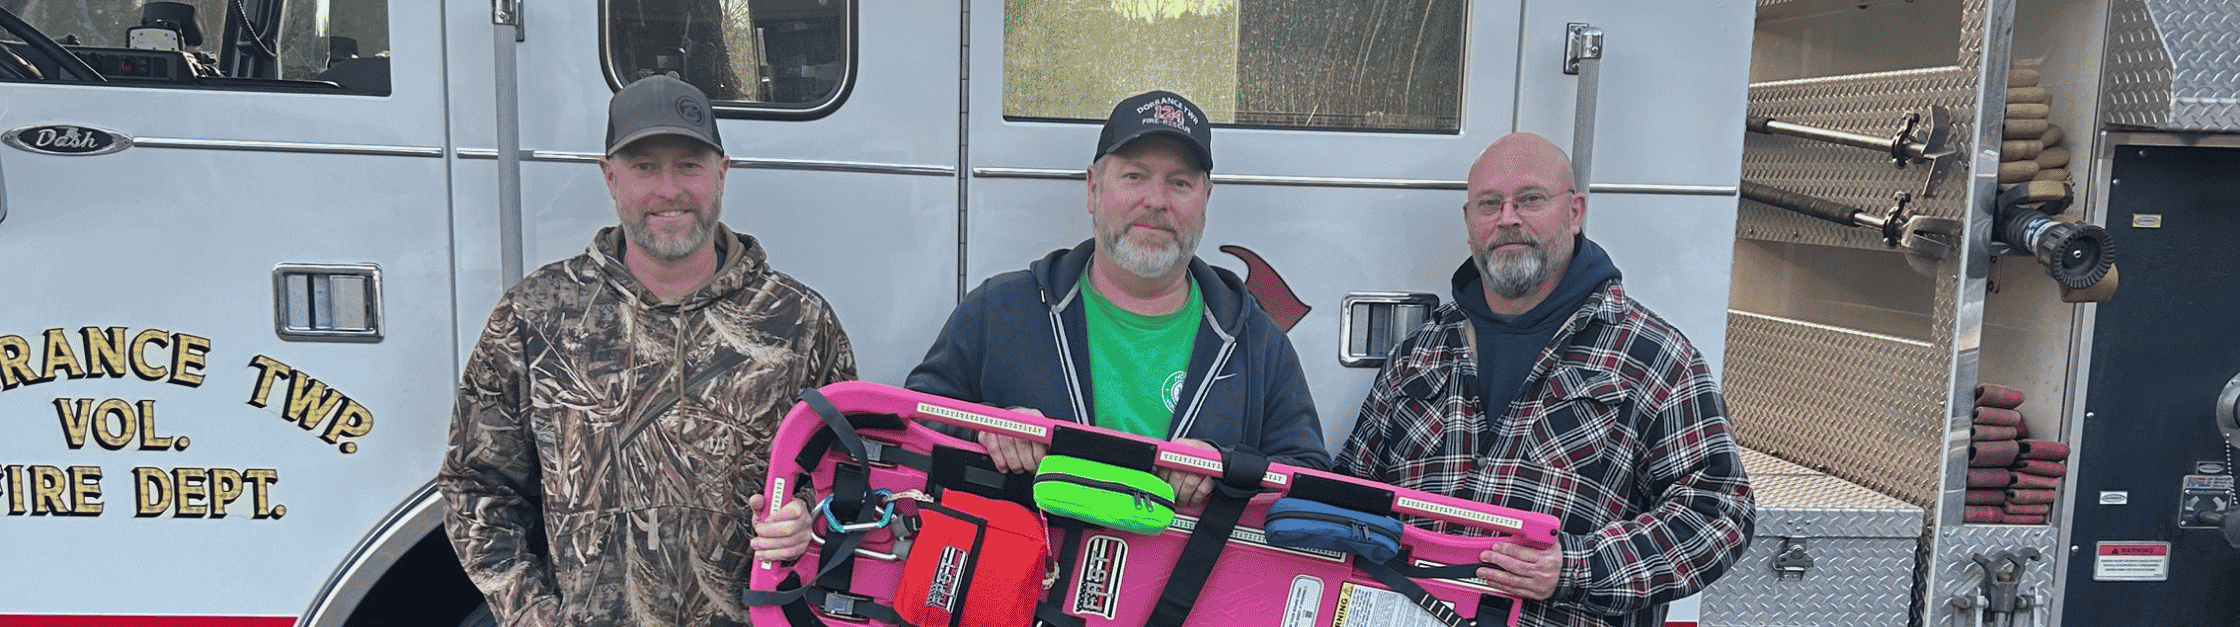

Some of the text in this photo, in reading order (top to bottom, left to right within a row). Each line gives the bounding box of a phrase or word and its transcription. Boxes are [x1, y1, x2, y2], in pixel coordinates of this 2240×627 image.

[1136, 97, 1183, 115] DORRANCE
[1153, 105, 1185, 125] 124
[36, 128, 98, 148] Dash
[52, 397, 191, 451] VOL.
[246, 354, 374, 454] TWP.
[0, 464, 287, 519] IRE DEPT.
[1082, 550, 1114, 611] FAST
